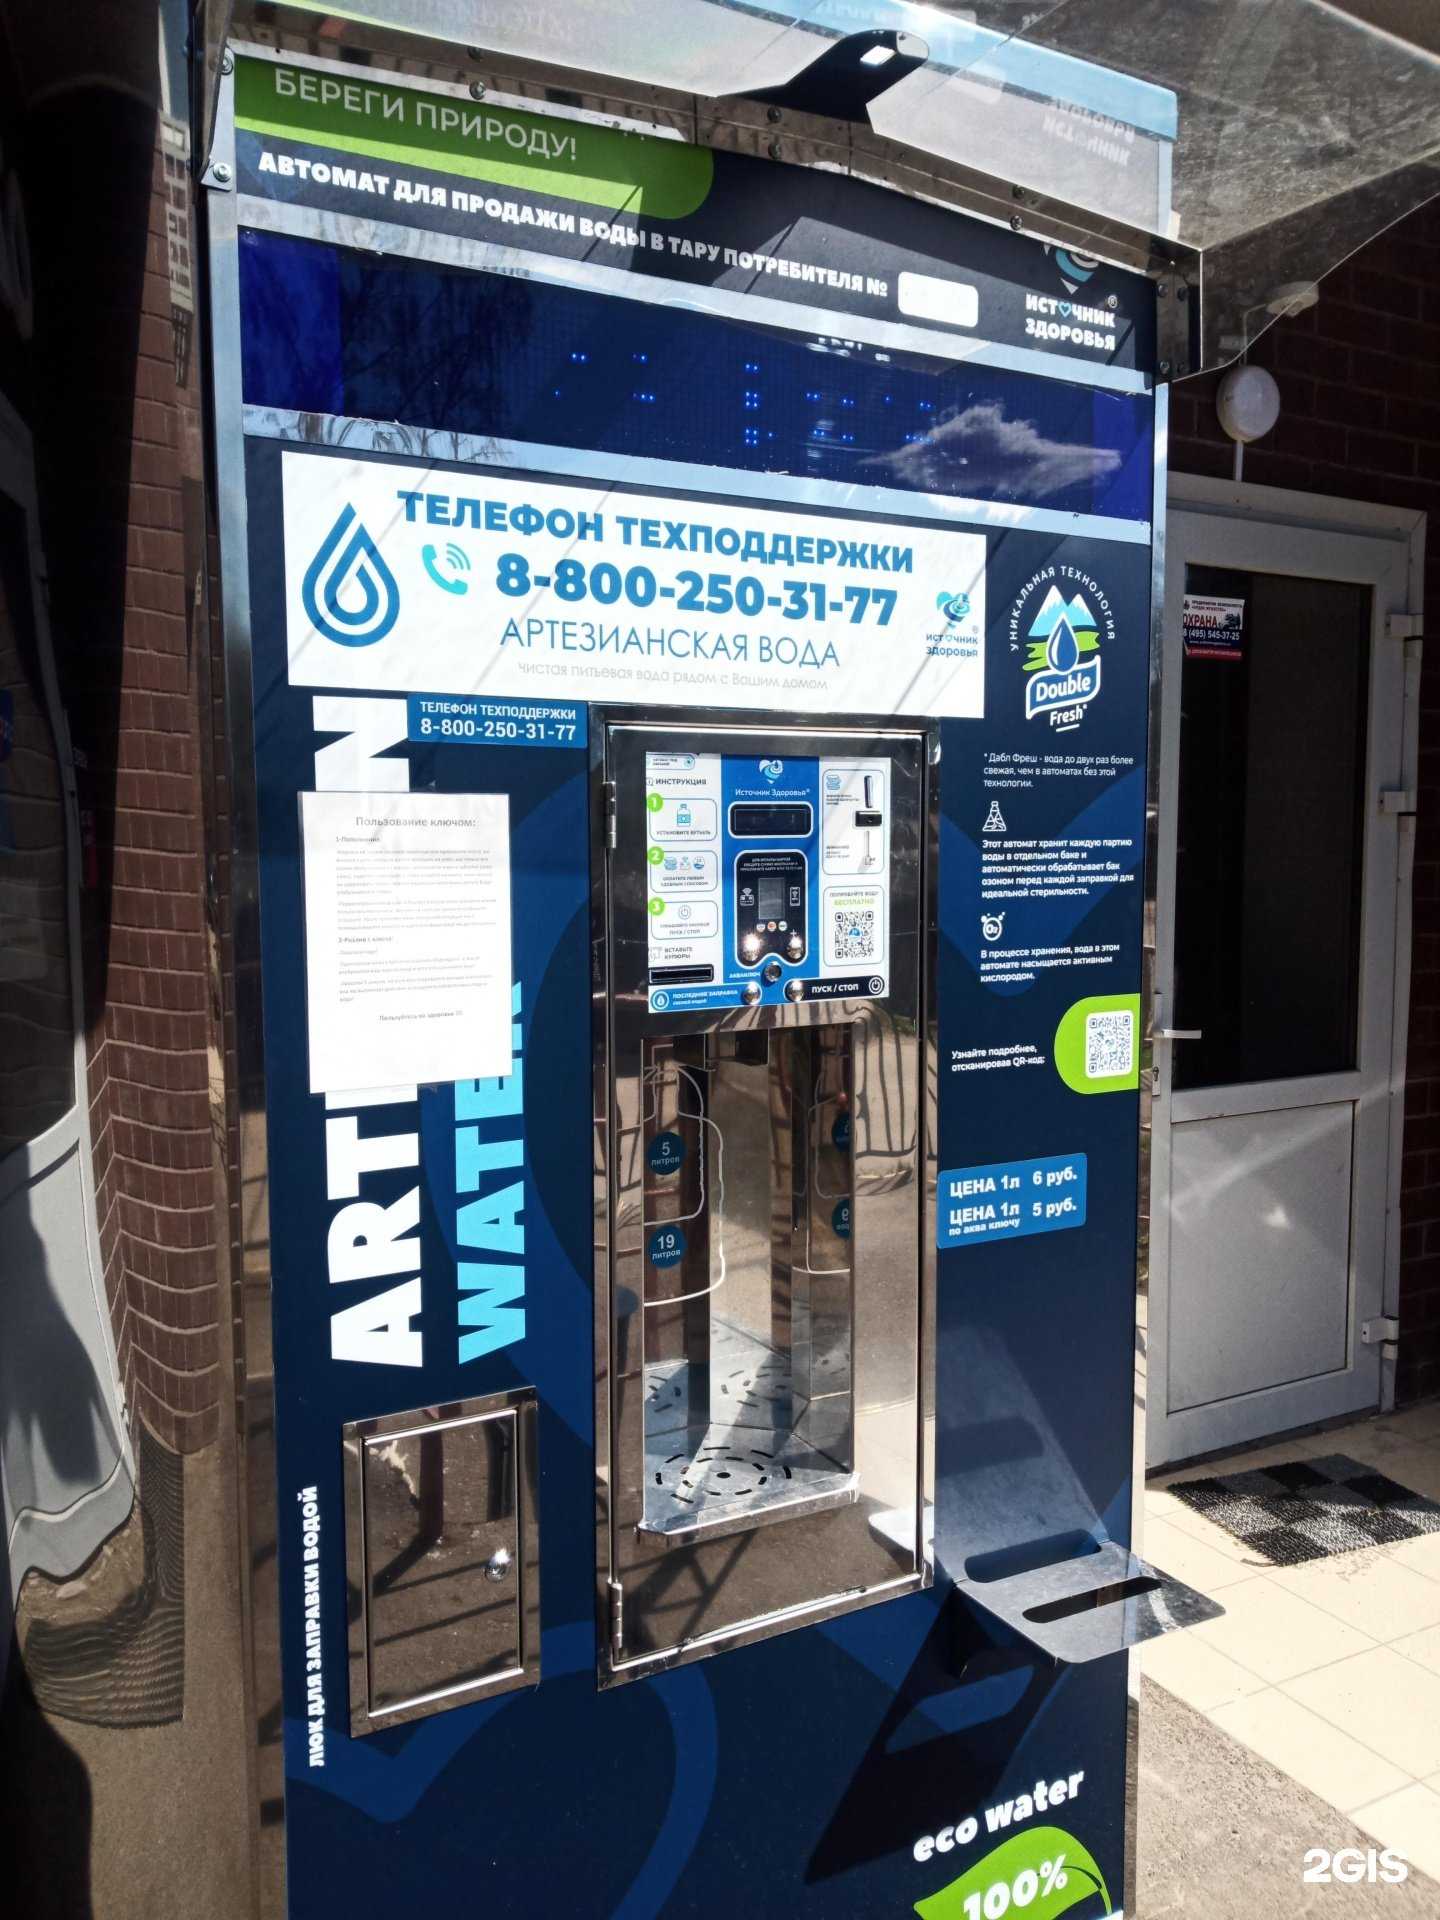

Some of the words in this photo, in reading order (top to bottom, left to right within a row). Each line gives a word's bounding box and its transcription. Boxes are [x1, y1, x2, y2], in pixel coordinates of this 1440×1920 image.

[274, 68, 405, 123] БЕРЕГИ
[415, 103, 578, 162] ПРИРОДУ!
[258, 152, 390, 195] АВТОМАТ
[393, 179, 448, 207] ДЛЯ
[452, 190, 576, 234] ПРОДАЖИ
[579, 218, 647, 250] ВОДЫ
[651, 232, 664, 252] В
[668, 235, 721, 263] ТАРУ
[724, 248, 863, 292] ПОТРЕБИТЕЛЯ
[867, 276, 888, 298] №
[1025, 317, 1117, 352] ЗДОРОВЬЯ
[397, 490, 604, 542] ТЕЛЕФОН
[616, 516, 914, 574] ТЕХПОДДЕРЖКИ
[496, 553, 898, 627] 8-800-250-31-77
[1010, 566, 1055, 652] УНИКАЛЬНАЯ
[1060, 565, 1116, 641] ТЕХНОЛОГИЯ
[500, 617, 749, 662] АРТЕЗИАНСКАЯ
[759, 636, 841, 669] ВОДА
[519, 662, 568, 677] чистая
[571, 665, 633, 681] питьевая
[637, 668, 670, 683] вода
[672, 671, 717, 687] рядом
[720, 676, 729, 686] с
[731, 673, 780, 689] Вашим
[782, 677, 829, 690] домом
[1035, 675, 1092, 703] Double
[420, 701, 477, 715] ТЕЛЕФОН
[480, 704, 577, 720] ТЕХПОДДЕРЖКИ
[420, 718, 577, 741] 8-800-250-31-77
[989, 752, 1011, 763] Дабл
[1013, 753, 1038, 764] Фреш
[1044, 755, 1063, 764] вода
[1065, 756, 1075, 765] до
[1076, 756, 1094, 766] двух
[1095, 757, 1109, 766] раз
[1110, 755, 1134, 765] более
[983, 767, 1016, 776] свежая,
[1018, 767, 1033, 775] чем
[1042, 768, 1082, 776] автоматах
[1083, 767, 1097, 776] без
[1098, 767, 1116, 776] этой
[983, 779, 1034, 788] технологии.
[735, 788, 770, 796] Источник
[355, 815, 428, 827] Пользование
[430, 817, 477, 828] ключом:
[982, 840, 1002, 849] Этот
[1003, 840, 1037, 849] автомат
[1038, 840, 1069, 849] хранит
[1069, 840, 1102, 849] каждую
[1103, 839, 1133, 848] партию
[651, 850, 659, 860] 2
[982, 853, 1005, 862] воды
[1013, 852, 1059, 861] отдельном
[1060, 850, 1080, 859] баке
[981, 865, 1046, 874] автоматически
[1047, 862, 1105, 873] обрабатывает
[1105, 861, 1120, 870] бак
[981, 877, 1014, 886] озоном
[1015, 876, 1042, 886] перед
[1043, 874, 1075, 884] каждой
[1076, 872, 1118, 883] заправкой
[1119, 874, 1135, 883] для
[981, 888, 1029, 898] идеальной
[1030, 887, 1090, 897] стерильности.
[981, 950, 987, 958] В
[988, 949, 1030, 959] процессе
[1031, 946, 1073, 957] хранения,
[1074, 944, 1093, 954] вода
[1101, 943, 1120, 952] этом
[980, 962, 1019, 971] автомате
[1021, 959, 1071, 969] насыщается
[1073, 955, 1112, 965] активным
[980, 972, 1035, 983] кислородом.
[811, 984, 832, 993] ПУСК
[838, 983, 859, 992] СТОП
[952, 1049, 987, 1060] Узнайте
[988, 1045, 1037, 1056] подробнее,
[952, 1059, 1011, 1071] отсканировав
[661, 1142, 671, 1156] 5
[651, 1156, 680, 1166] литров
[950, 1177, 996, 1199] ЦЕНА
[1001, 1175, 1020, 1190] 1л
[1032, 1171, 1042, 1185] 6
[1046, 1166, 1078, 1187] руб.
[949, 1204, 996, 1226] ЦЕНА
[1000, 1202, 1020, 1217] 1л
[1032, 1202, 1042, 1217] 5
[1046, 1197, 1077, 1218] руб.
[949, 1227, 961, 1236] по
[963, 1223, 987, 1234] аква
[988, 1218, 1020, 1231] ключу
[657, 1234, 675, 1249] 19
[652, 1249, 681, 1260] литров
[297, 1486, 321, 1561] ВОДОЙ
[304, 1562, 322, 1671] ЗАПРАВКИ
[306, 1673, 326, 1716] ДЛЯ
[308, 1717, 325, 1768] ЛЮК
[913, 1816, 978, 1863] eco
[984, 1770, 1085, 1833] water
[962, 1853, 1069, 1920] 100%
